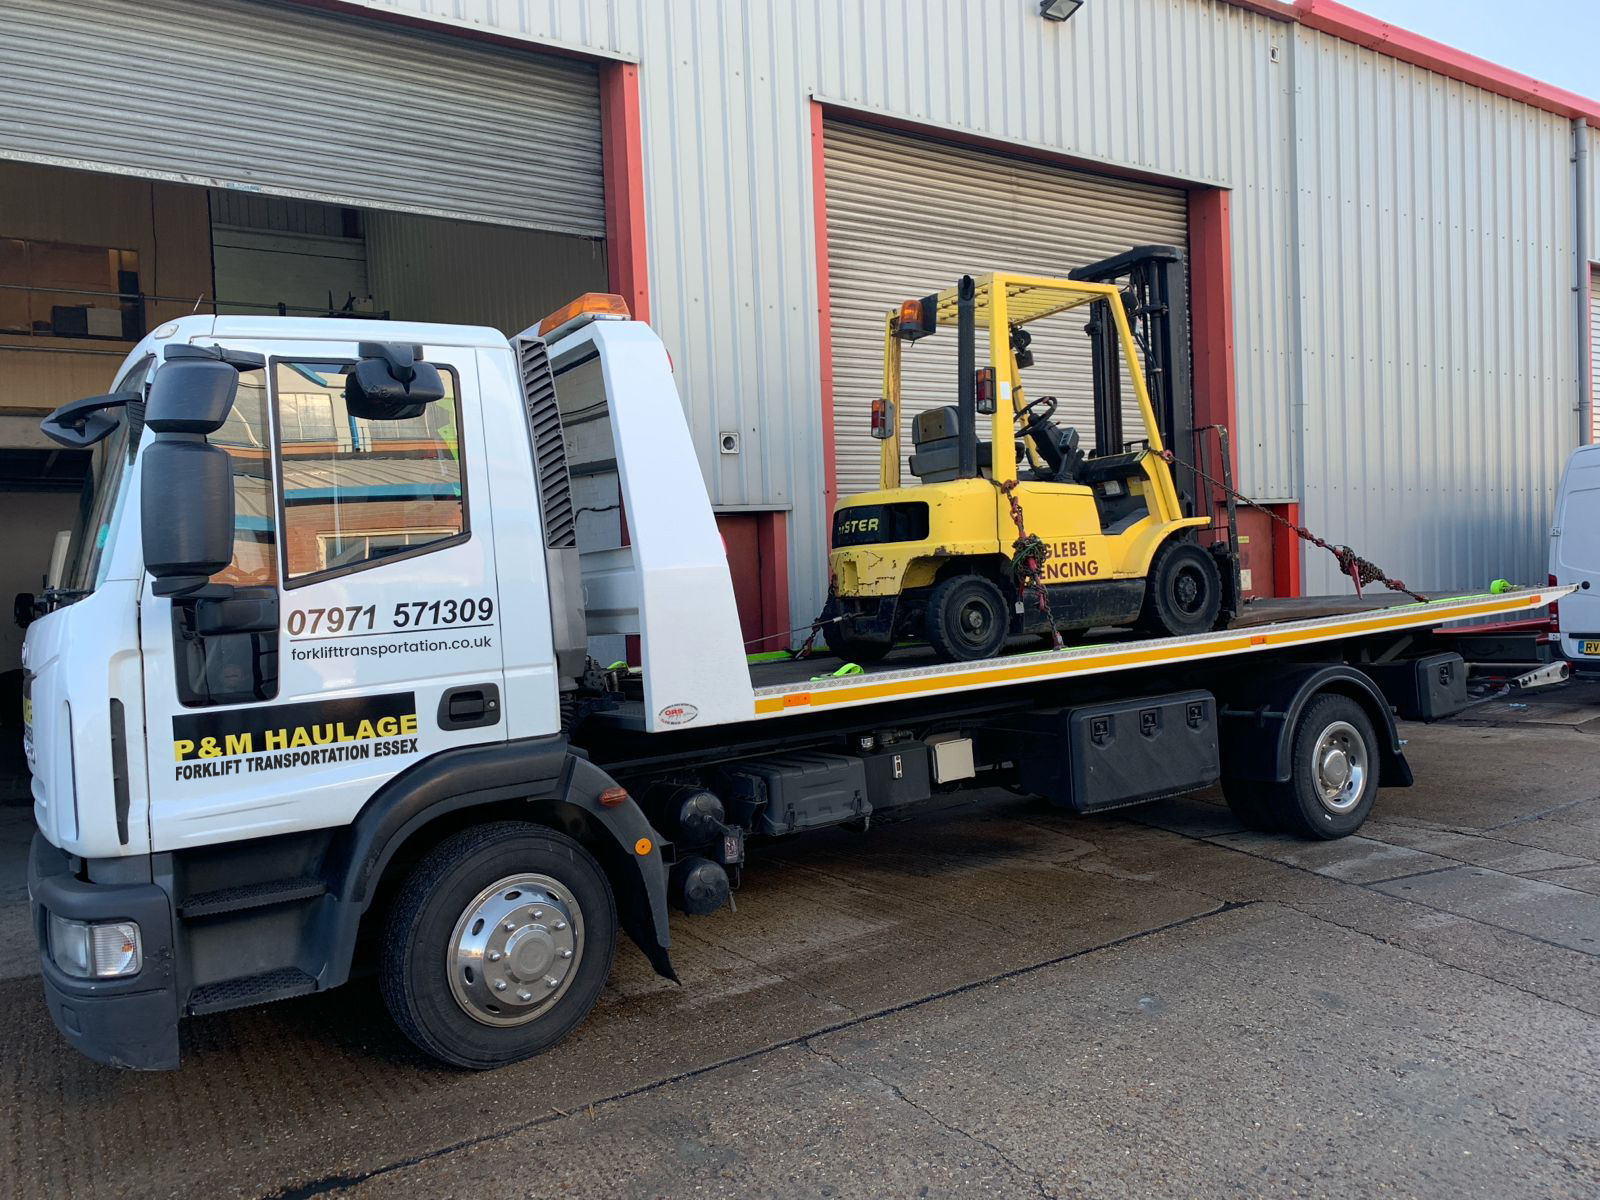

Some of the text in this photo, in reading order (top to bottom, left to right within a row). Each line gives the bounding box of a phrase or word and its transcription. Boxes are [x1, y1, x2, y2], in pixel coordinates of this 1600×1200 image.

[1045, 541, 1086, 559] GLEBE
[1039, 560, 1098, 580] ENCING
[287, 597, 494, 636] 07971 571309
[291, 636, 492, 660] forklifttransportation.co.uk
[173, 714, 417, 762] P&M HAULAGE
[175, 738, 418, 781] FORKLIFT TRANSPORTATION ESSEX
